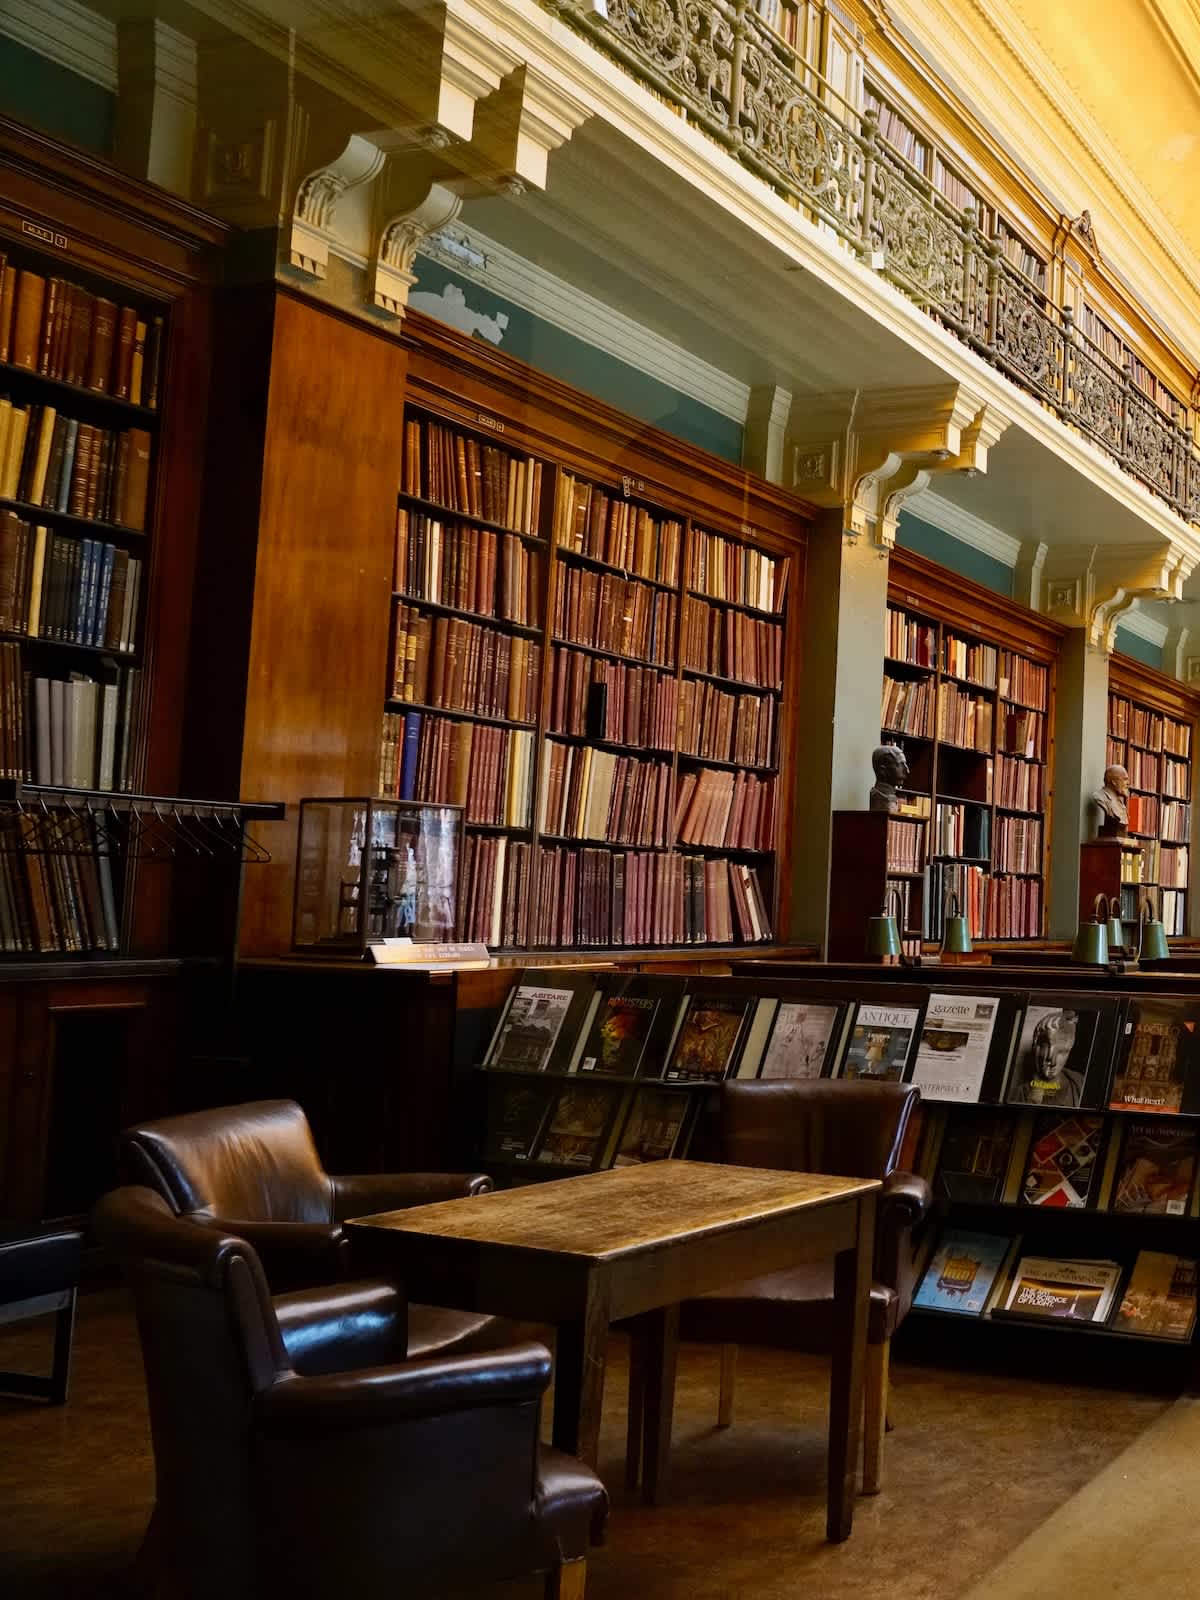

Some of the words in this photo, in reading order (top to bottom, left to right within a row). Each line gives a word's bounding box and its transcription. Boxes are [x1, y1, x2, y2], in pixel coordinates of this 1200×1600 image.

[530, 991, 569, 1001] ABITARE
[931, 1003, 970, 1017] gazette
[1124, 1095, 1143, 1104] What
[1143, 1096, 1166, 1106] next?
[1017, 1297, 1029, 1305] OF
[1019, 1292, 1036, 1300] AND
[1036, 1294, 1069, 1304] SCIENCE
